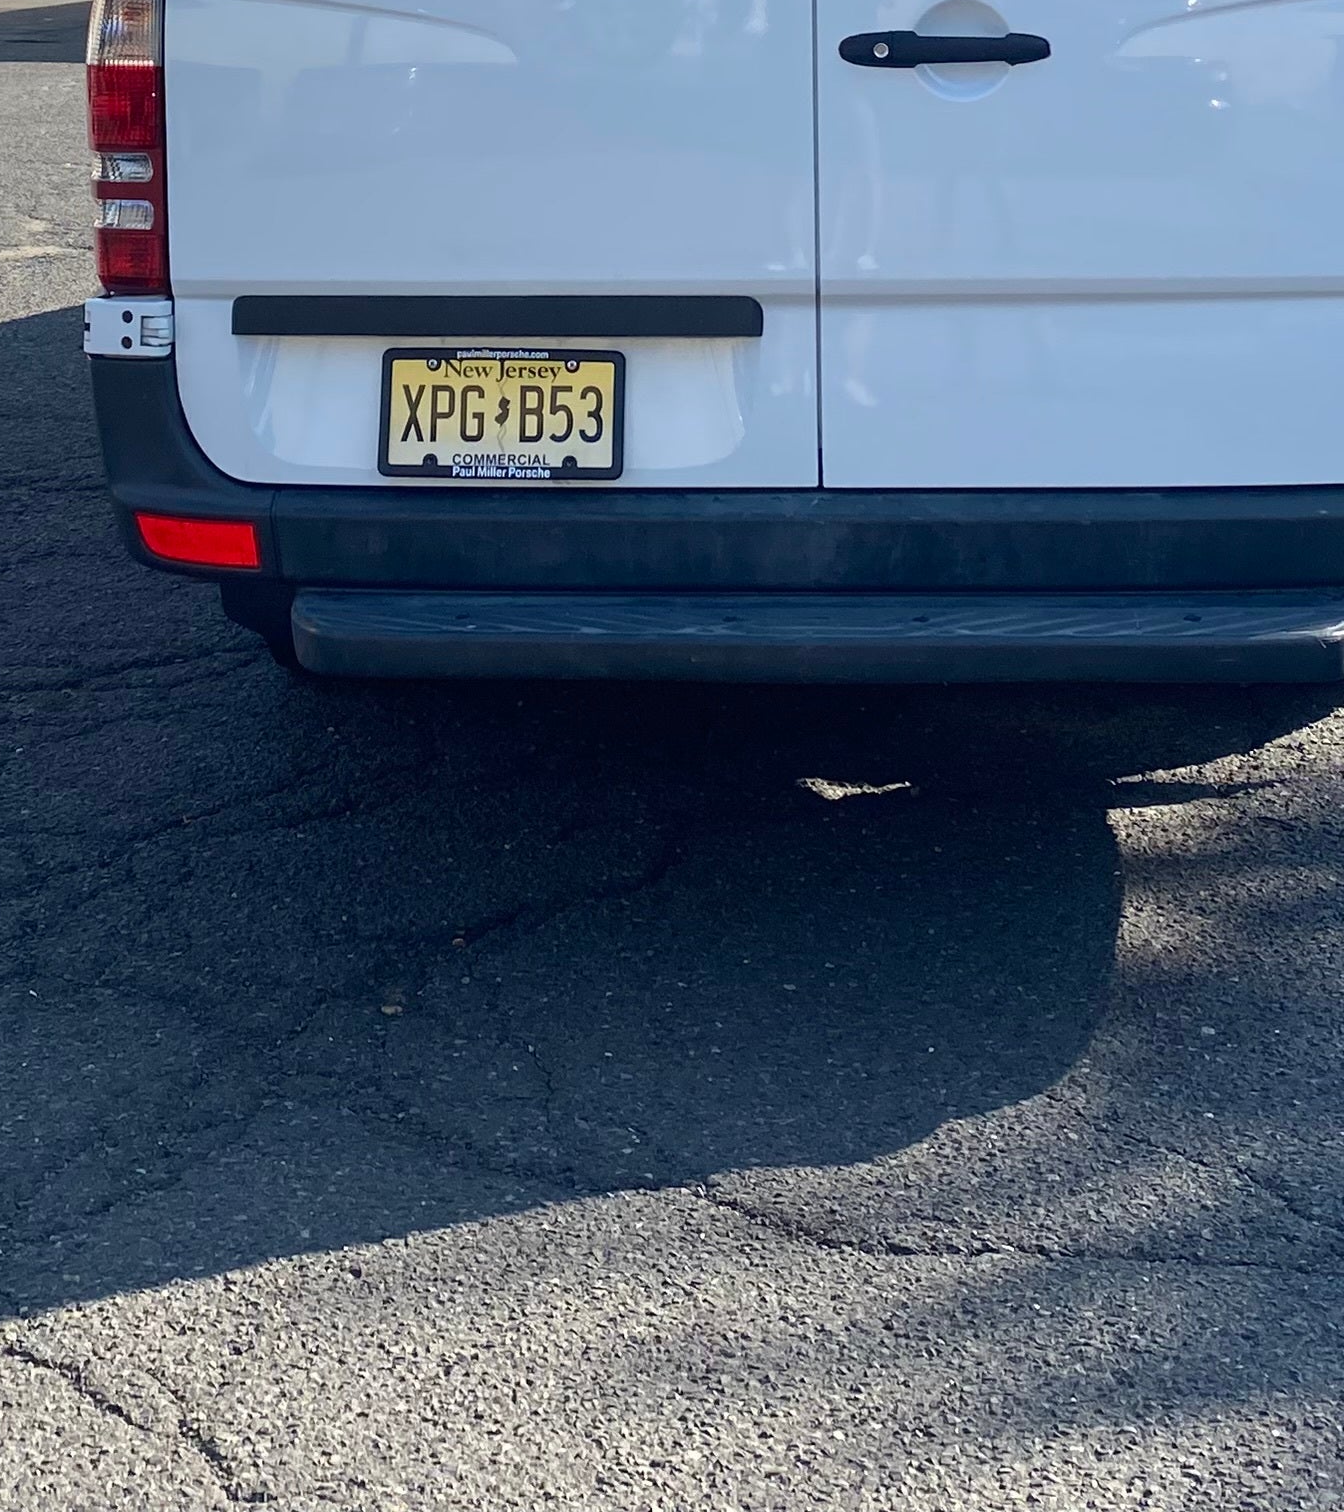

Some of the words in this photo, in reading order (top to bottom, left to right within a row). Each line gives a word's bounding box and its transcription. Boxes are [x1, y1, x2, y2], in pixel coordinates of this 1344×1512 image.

[456, 349, 549, 360] paulmillerporsche.com
[444, 360, 493, 379] New
[496, 360, 562, 384] Jersey
[400, 384, 485, 443] XPG
[519, 385, 604, 444] B53
[452, 453, 551, 466] COMMERCIAL
[452, 466, 475, 477] Paul
[477, 467, 507, 478] Miller
[508, 467, 551, 479] Porsche
